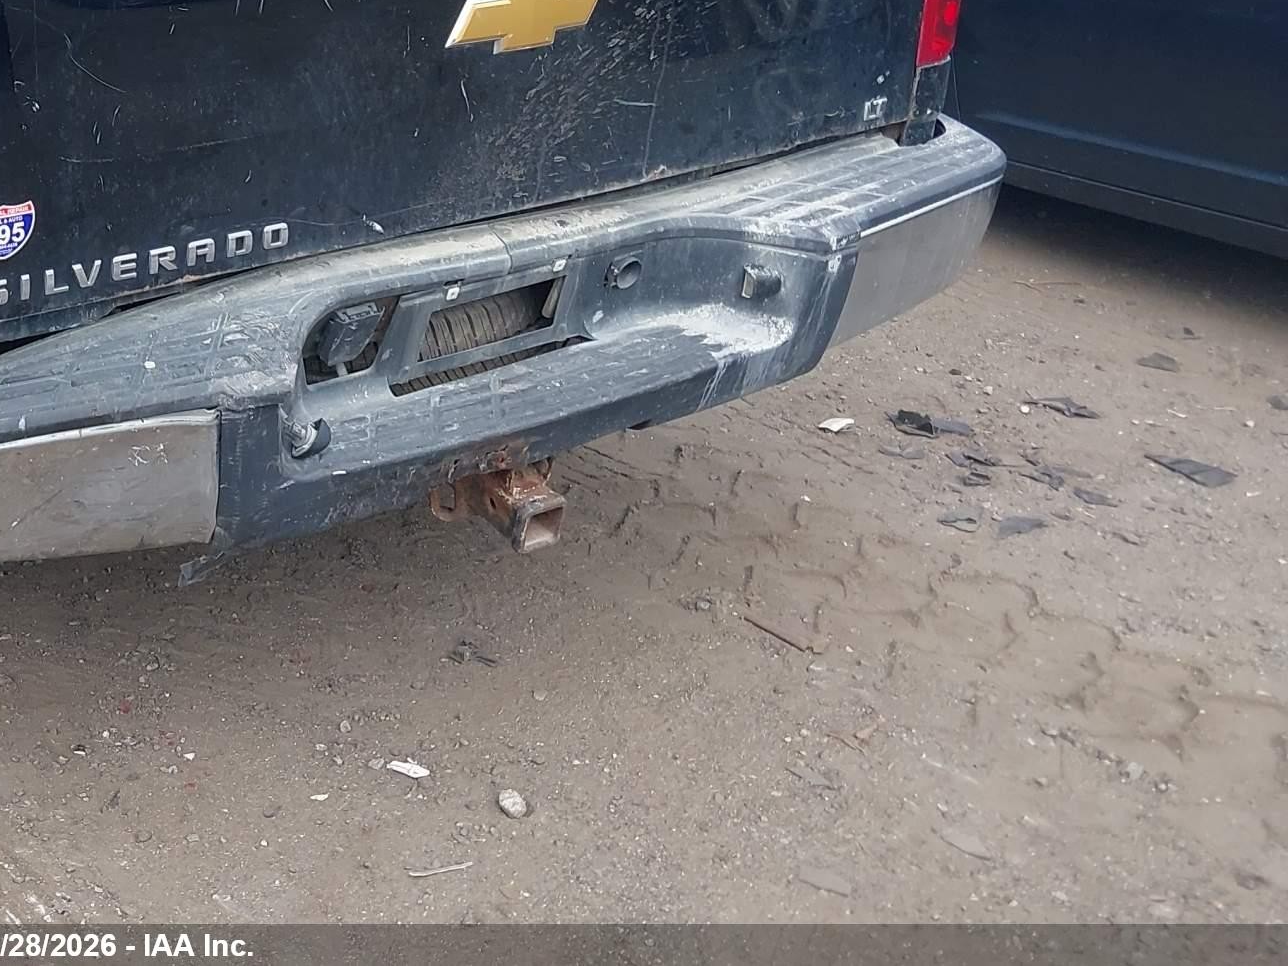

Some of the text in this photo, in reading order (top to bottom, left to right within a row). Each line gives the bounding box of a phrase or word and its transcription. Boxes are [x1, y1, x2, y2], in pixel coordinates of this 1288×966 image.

[863, 96, 888, 122] LT
[7, 205, 30, 215] REPAIR
[9, 215, 24, 223] AUTO
